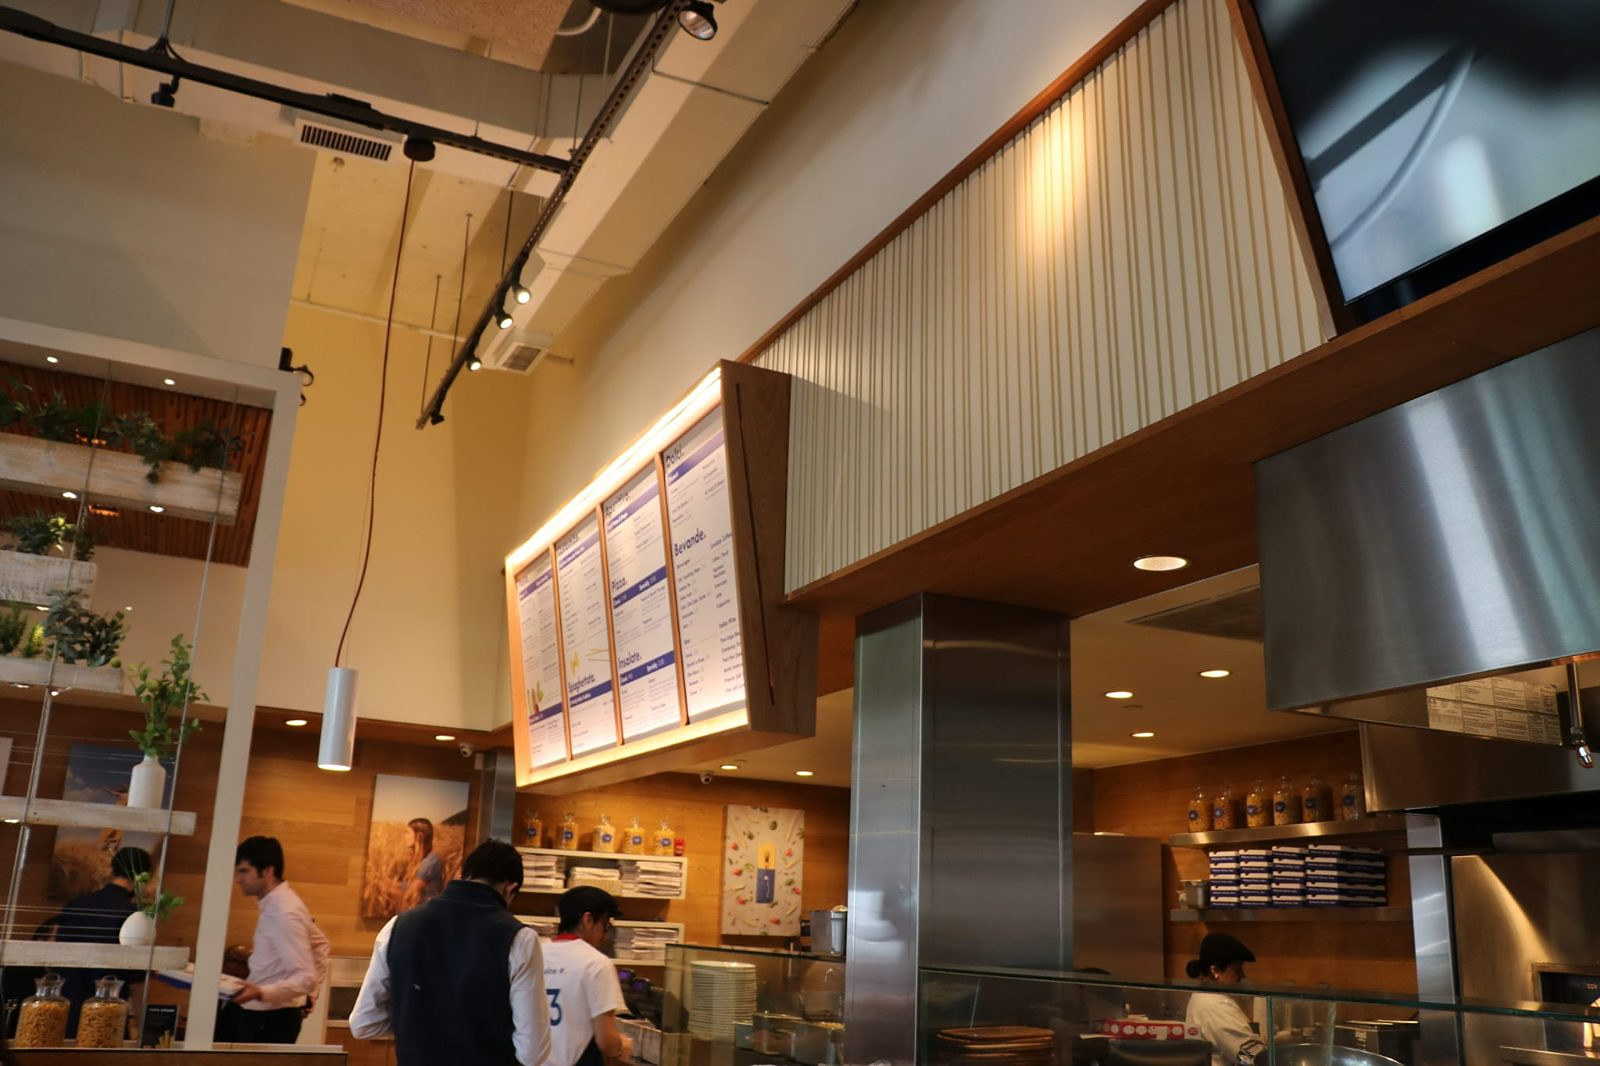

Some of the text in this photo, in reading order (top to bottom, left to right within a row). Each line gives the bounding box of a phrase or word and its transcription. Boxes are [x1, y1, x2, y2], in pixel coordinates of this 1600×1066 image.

[674, 528, 706, 557] Bevande.
[611, 577, 628, 593] Pizza.
[618, 650, 642, 670] Insalate.
